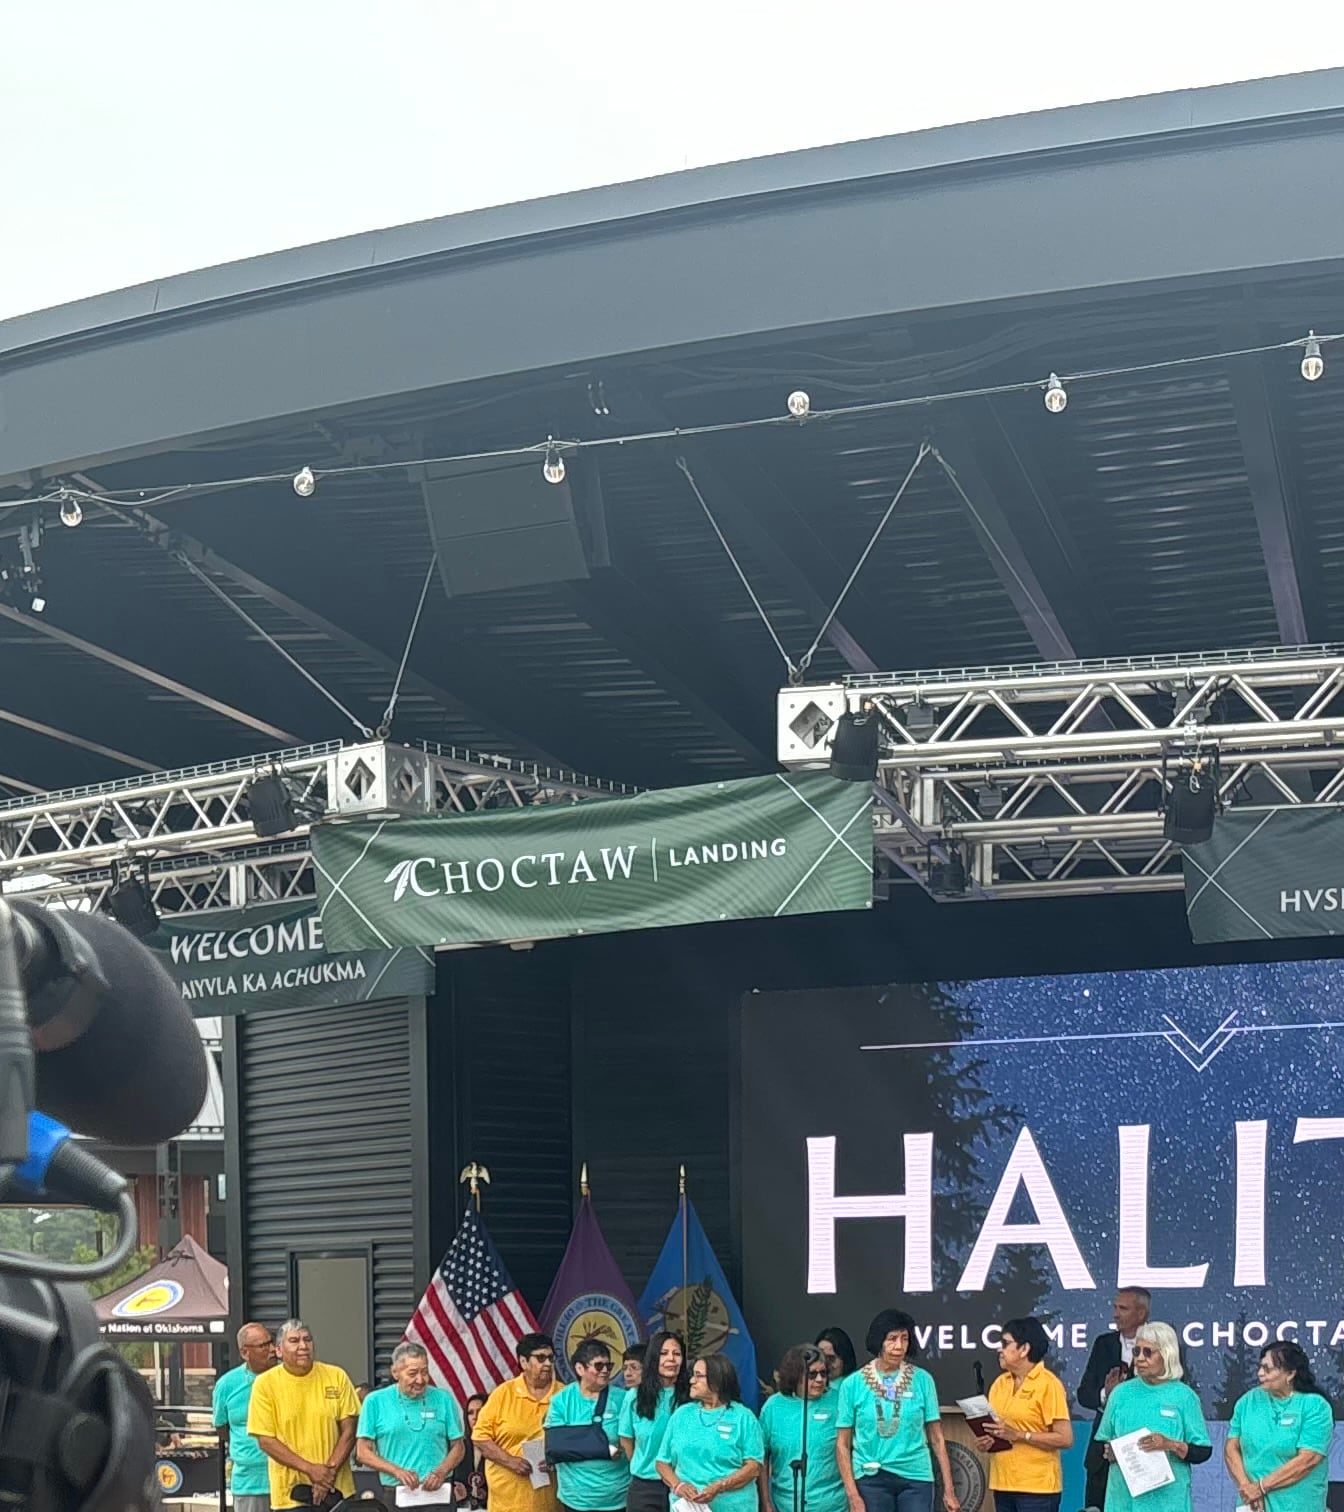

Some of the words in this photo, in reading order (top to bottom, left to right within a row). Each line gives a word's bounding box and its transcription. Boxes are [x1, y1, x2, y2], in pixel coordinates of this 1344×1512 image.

[407, 845, 638, 898] CHOCTAW
[668, 838, 787, 867] LANDING
[169, 916, 324, 965] WELCOME
[180, 975, 238, 1000] AIYVLA
[242, 972, 267, 993] KA
[271, 959, 366, 990] ACHUKMA
[914, 1323, 1087, 1349] WELCME
